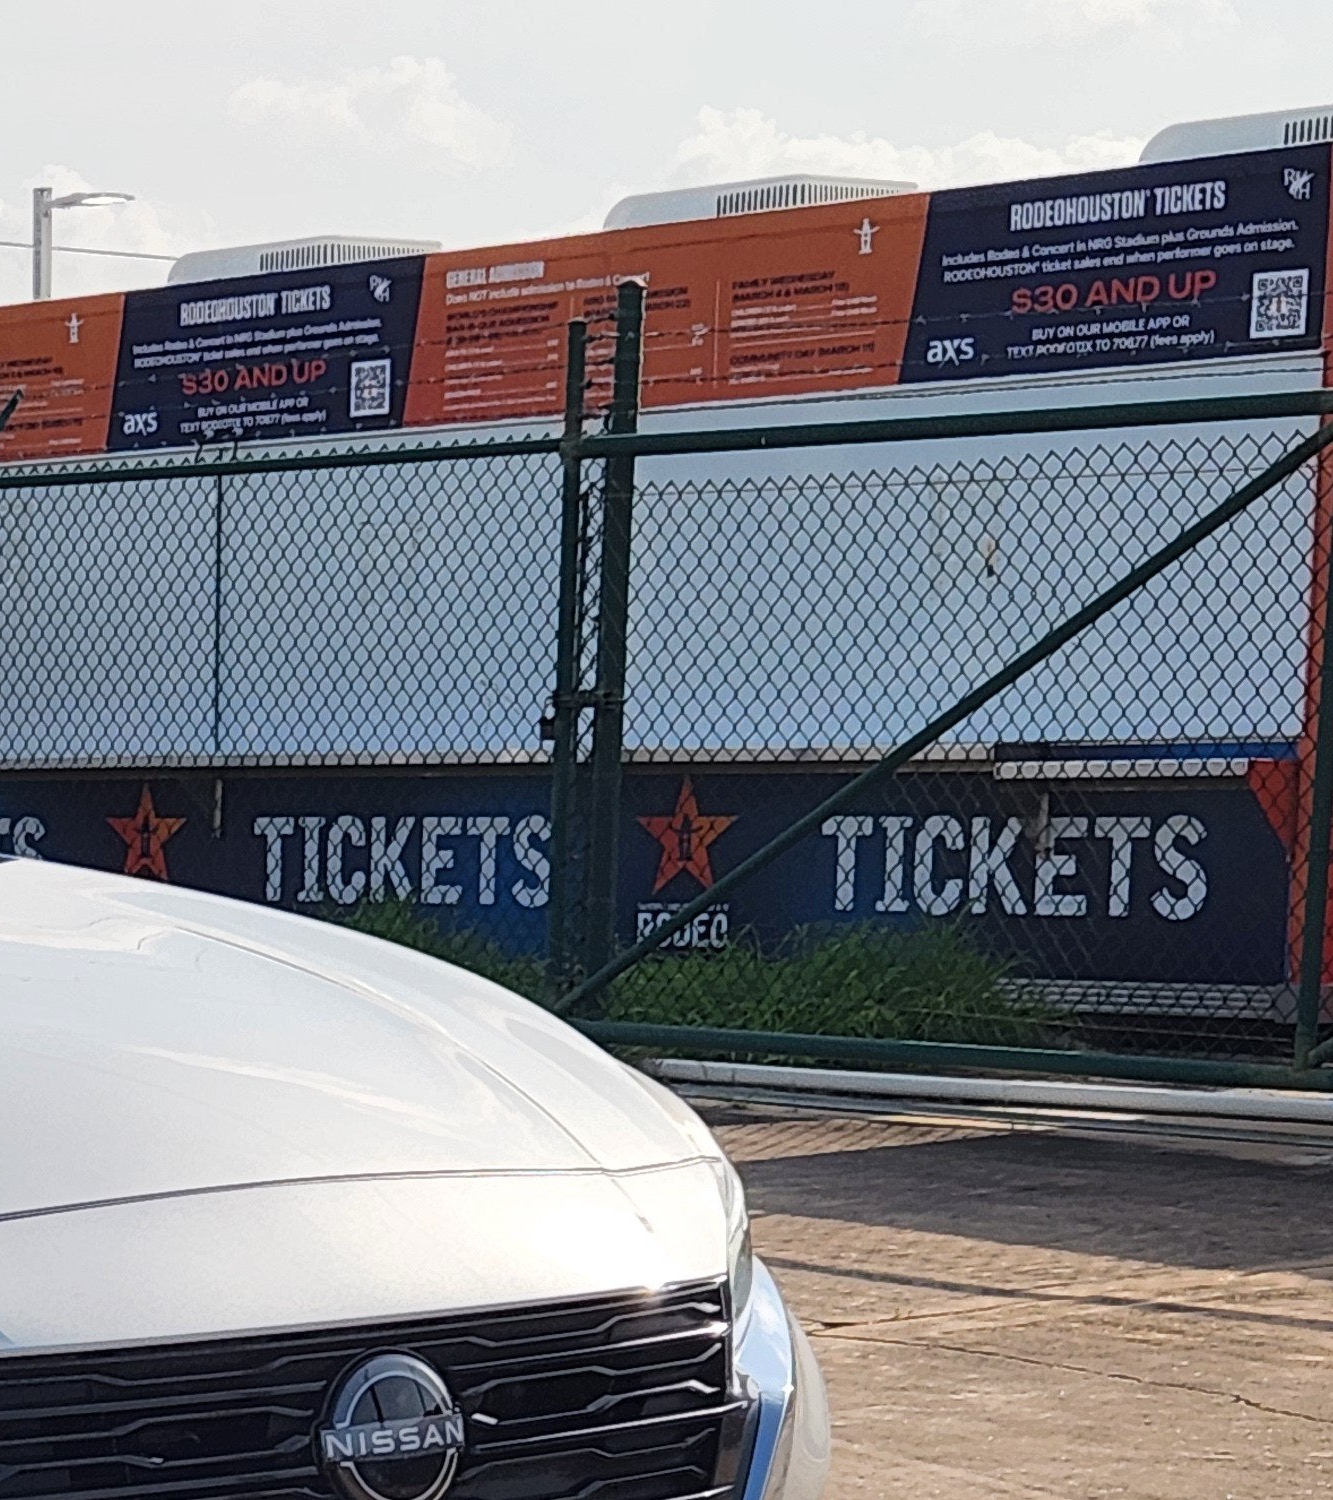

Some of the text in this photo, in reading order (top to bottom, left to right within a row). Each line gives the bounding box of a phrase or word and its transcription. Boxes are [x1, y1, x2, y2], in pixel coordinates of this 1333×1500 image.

[1153, 180, 1226, 216] TICKETS
[1088, 236, 1112, 250] NRG
[1186, 225, 1234, 241] Grounds
[1243, 240, 1258, 252] on
[281, 284, 331, 314] TICKETS
[1011, 269, 1217, 314] $30 AND UP
[1031, 314, 1191, 341] BUY ON OUR MOBILE APP OR
[1006, 345, 1034, 360] TEXT
[1095, 338, 1111, 352] TO
[234, 363, 288, 391] AND
[291, 358, 327, 384] UP
[253, 814, 553, 907] TICKETS
[820, 814, 1209, 921] TICKETS
[325, 1419, 464, 1458] NISSAN
